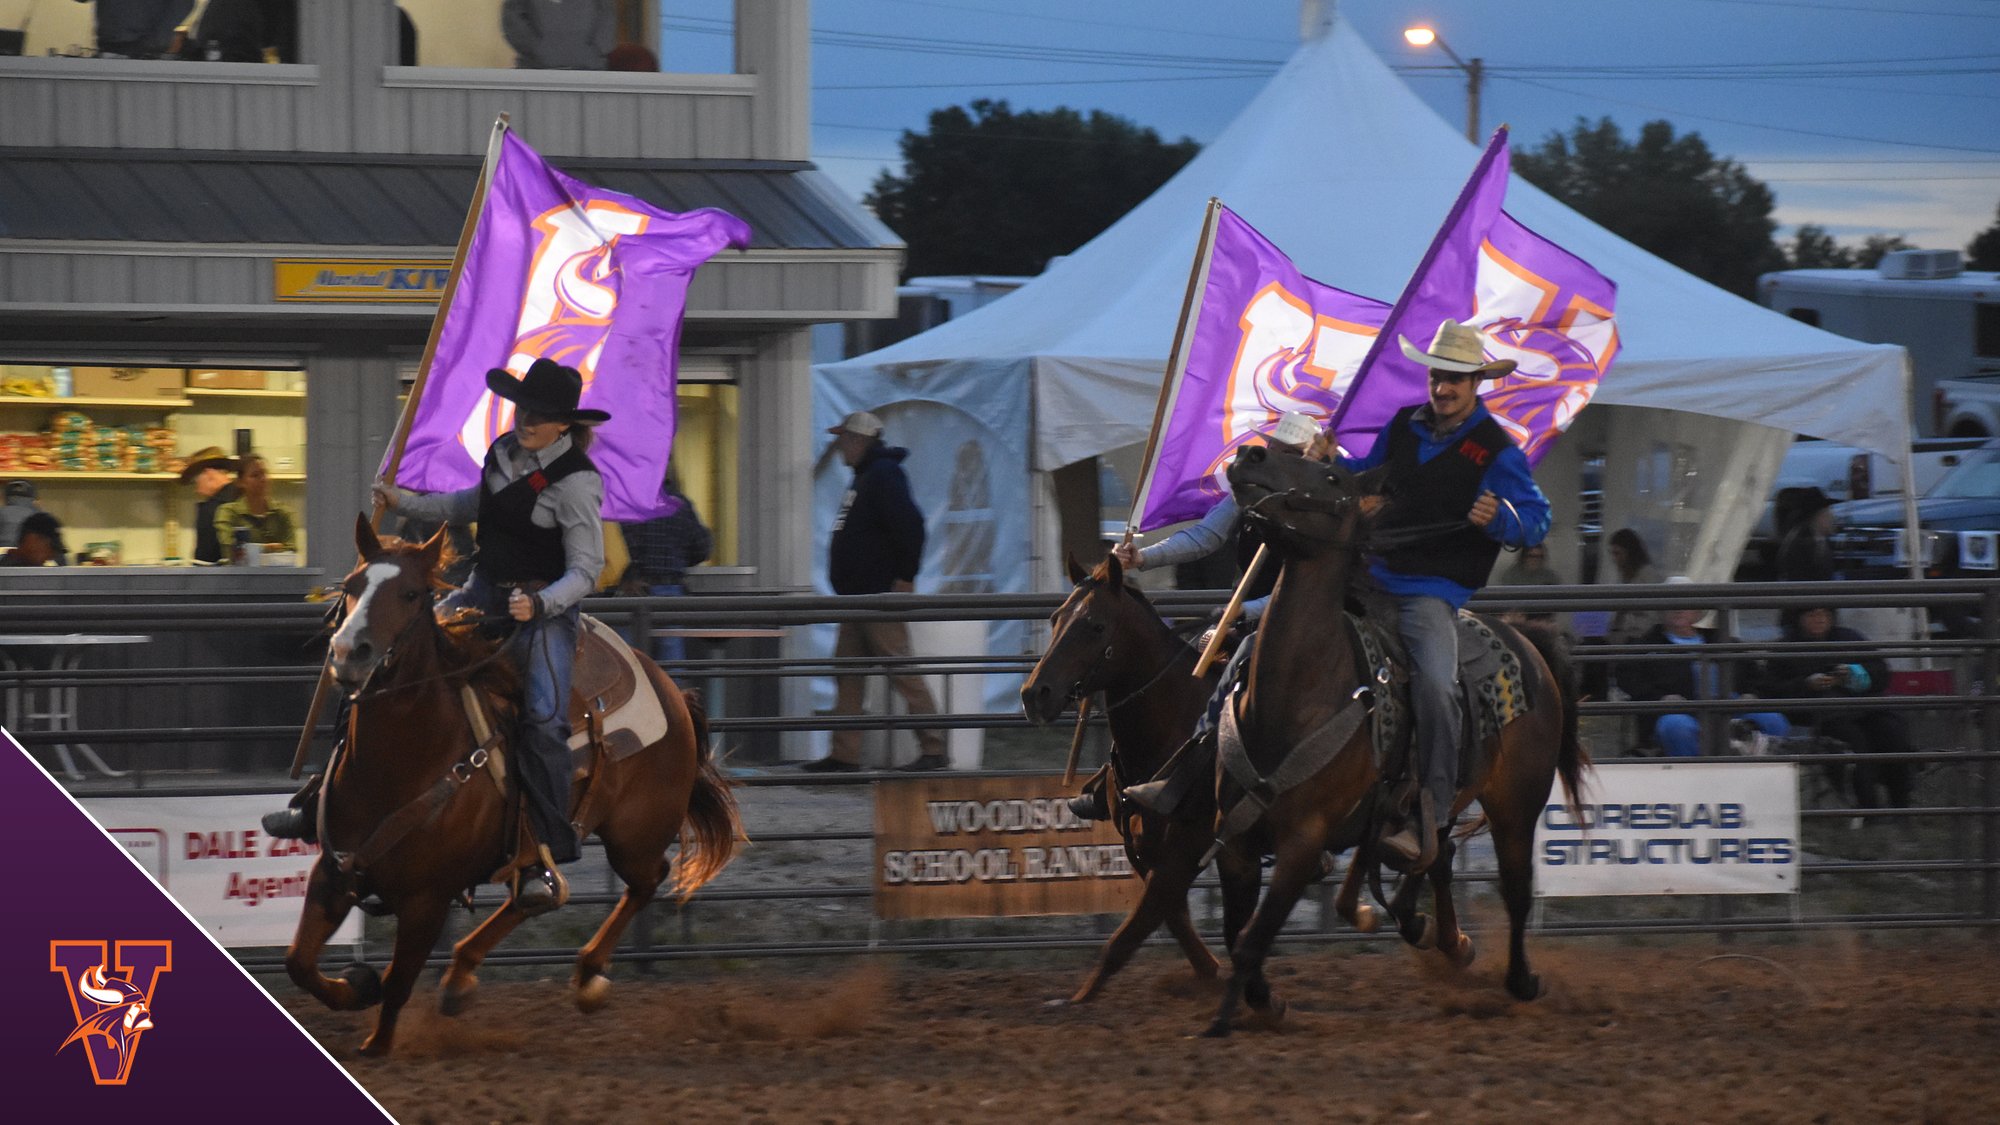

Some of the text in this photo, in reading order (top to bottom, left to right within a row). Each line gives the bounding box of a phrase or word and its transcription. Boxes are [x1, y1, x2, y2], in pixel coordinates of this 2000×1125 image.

[1544, 803, 1745, 831] CORESLAB
[184, 830, 260, 859] DALE
[1542, 837, 1797, 866] STRUCTURES
[884, 844, 1136, 884] SCHOOL RANCH
[224, 871, 307, 907] Agent
